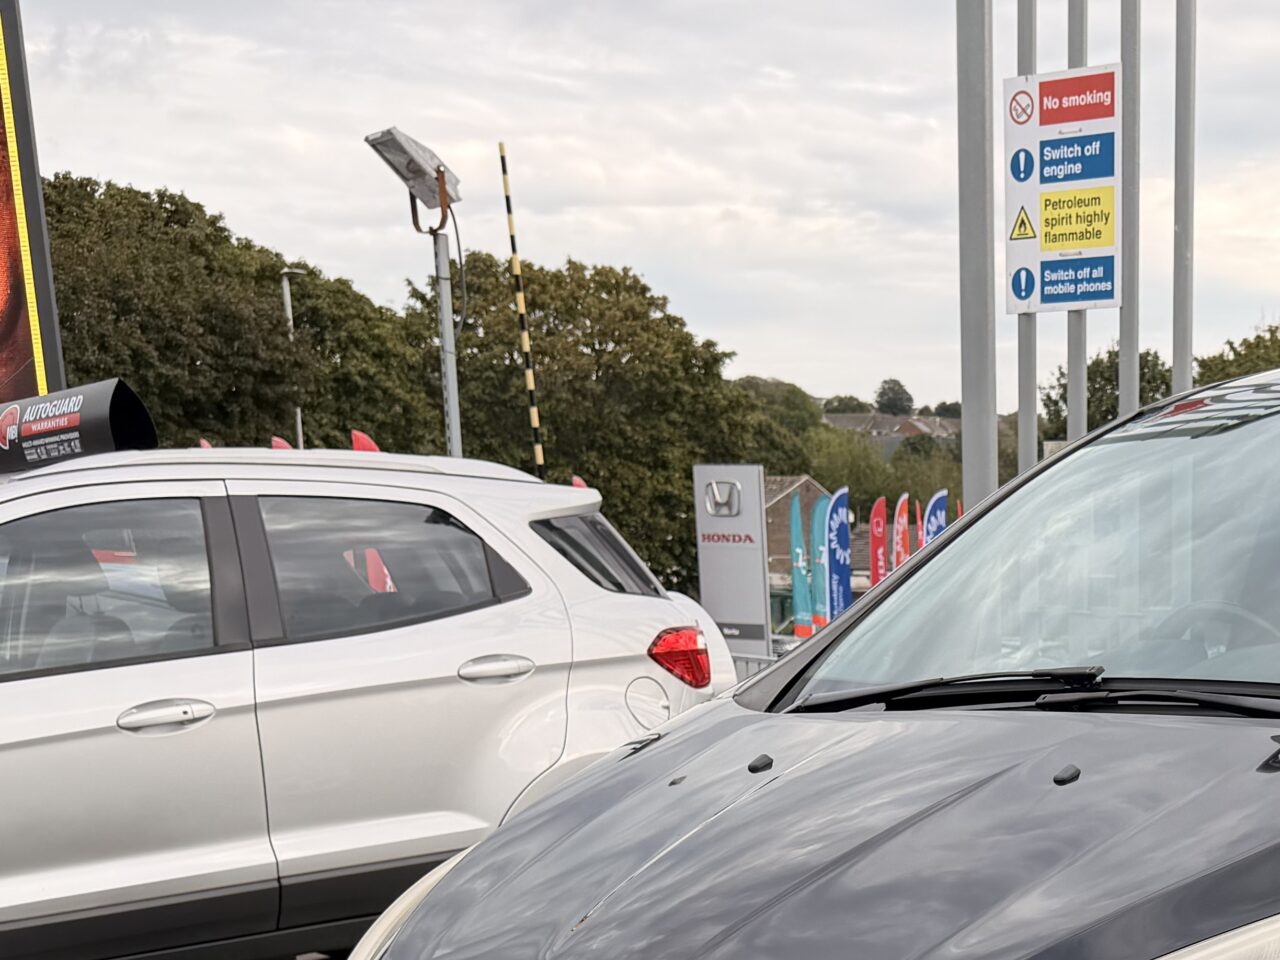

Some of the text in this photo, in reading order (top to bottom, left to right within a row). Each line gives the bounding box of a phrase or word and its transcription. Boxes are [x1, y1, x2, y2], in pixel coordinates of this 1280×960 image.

[1042, 90, 1112, 110] No smoking
[1043, 141, 1101, 161] Switch off
[1043, 161, 1082, 179] engine
[1044, 195, 1101, 211] Petroleum
[1044, 211, 1111, 230] spirit highly
[1044, 226, 1102, 244] flammable
[1044, 266, 1104, 282] Switch off all
[1044, 280, 1112, 295] mobile phones
[22, 395, 84, 423] AUTOGUARD
[31, 417, 69, 432] WARRANTIES
[701, 533, 755, 544] HONDA
